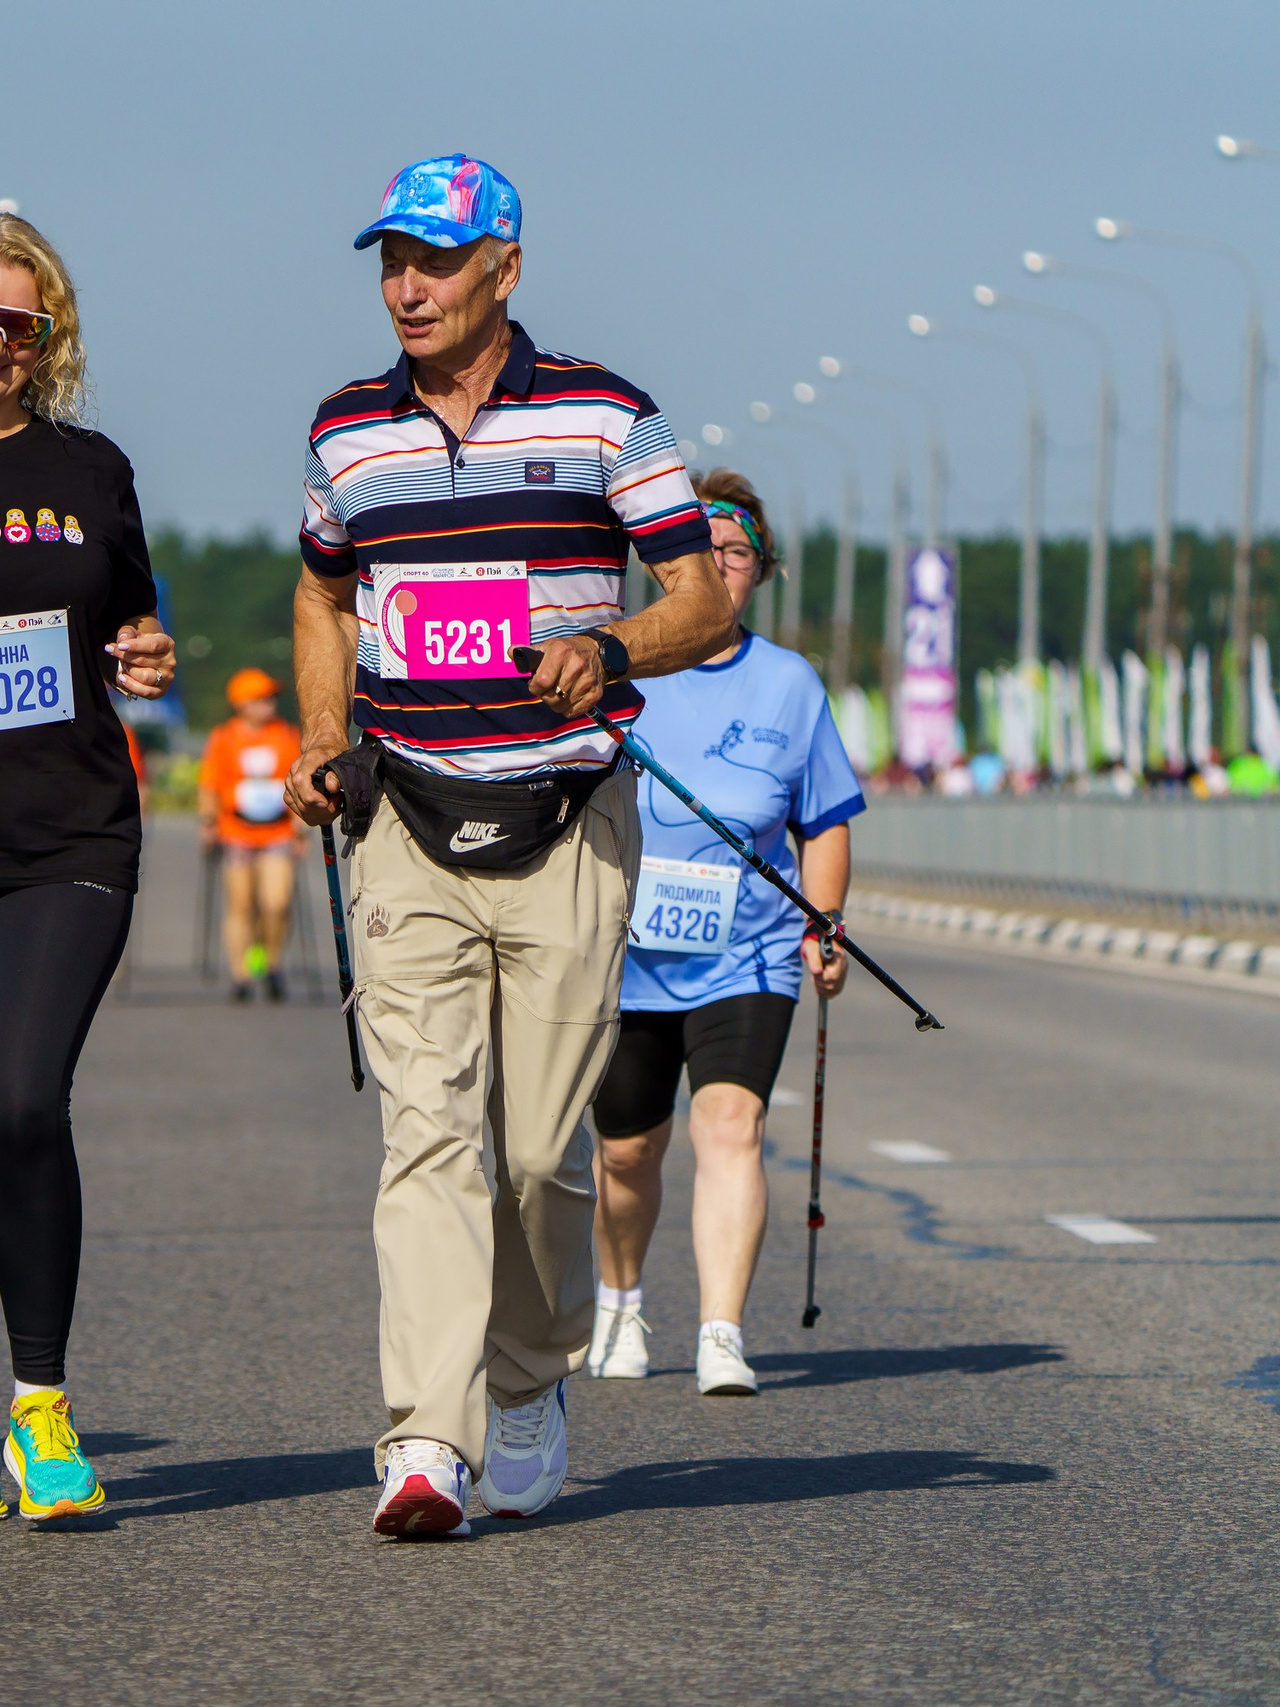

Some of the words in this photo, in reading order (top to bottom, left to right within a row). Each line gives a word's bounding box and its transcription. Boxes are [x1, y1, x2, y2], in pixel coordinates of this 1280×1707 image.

[486, 567, 501, 575] Пэй
[28, 618, 43, 627] Пэй
[424, 618, 513, 665] 5231
[458, 821, 500, 840] NIKE
[654, 883, 721, 905] ЛЮДМИЛА
[645, 904, 721, 943] 4326
